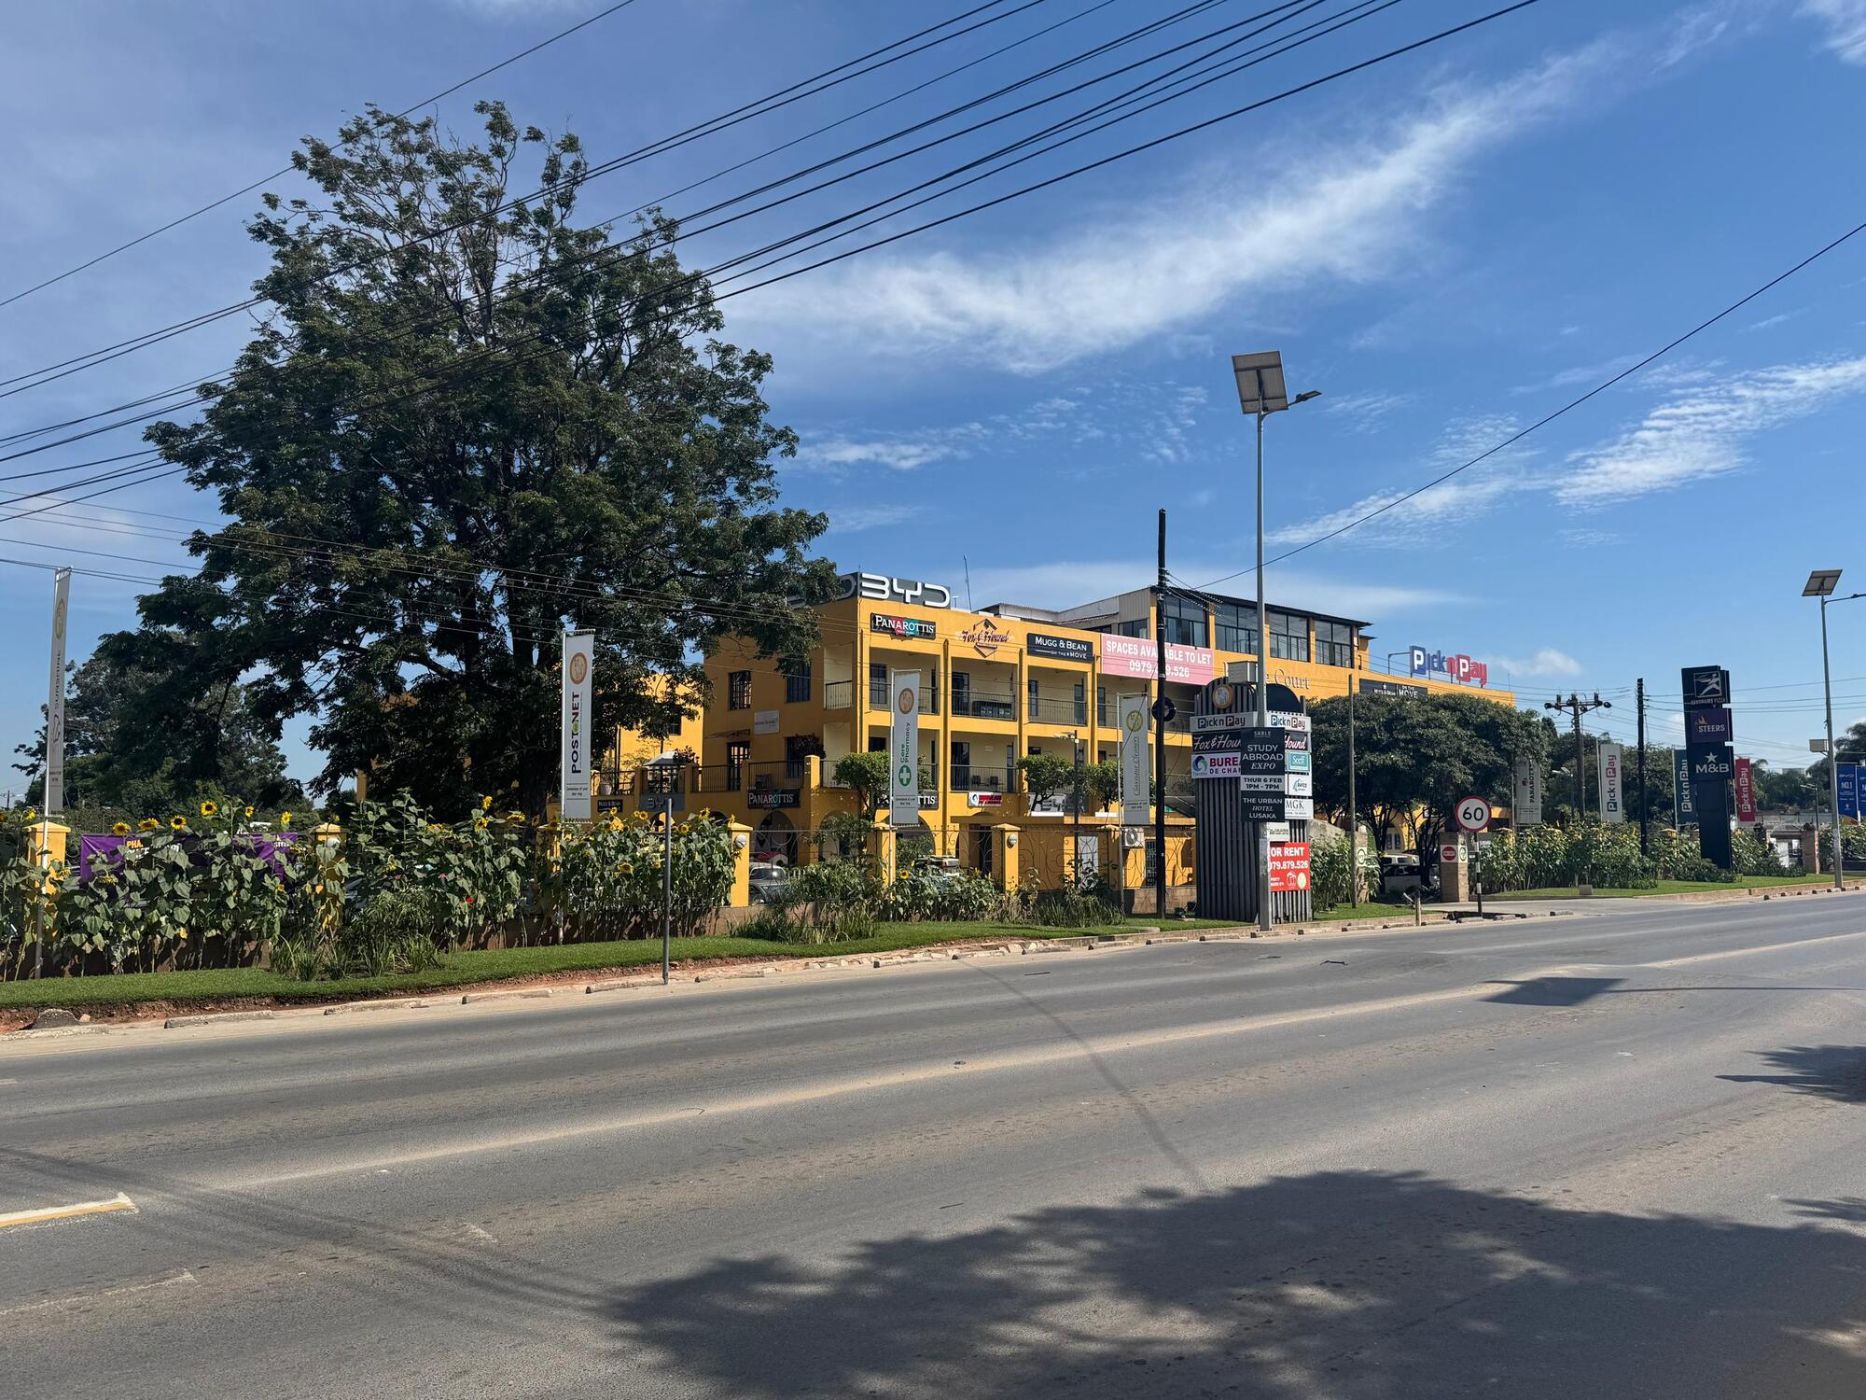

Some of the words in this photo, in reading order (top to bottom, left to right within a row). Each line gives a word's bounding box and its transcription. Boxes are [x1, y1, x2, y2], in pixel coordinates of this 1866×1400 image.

[861, 572, 950, 608] BYD
[874, 615, 935, 634] PANAROTTIS
[1059, 639, 1065, 649] &
[1070, 652, 1087, 660] MOVE
[1106, 640, 1138, 656] SPACES
[1140, 645, 1183, 661] AVAABLE
[1186, 652, 1196, 663] TO
[1197, 653, 1211, 665] LET
[1129, 660, 1190, 678] 0979.9.526
[1399, 688, 1418, 699] MOVE
[1698, 724, 1725, 733] STEERS
[1247, 744, 1278, 752] STUDY
[1210, 757, 1241, 767] BURE
[1242, 753, 1284, 761] ABROAD
[1251, 762, 1276, 770] EXPO
[1695, 763, 1729, 774] M&B
[748, 792, 794, 805] PANAROTTIS
[1286, 799, 1304, 809] MGK
[1463, 807, 1484, 821] 60
[1270, 847, 1283, 857] OR
[1284, 847, 1305, 857] RENT
